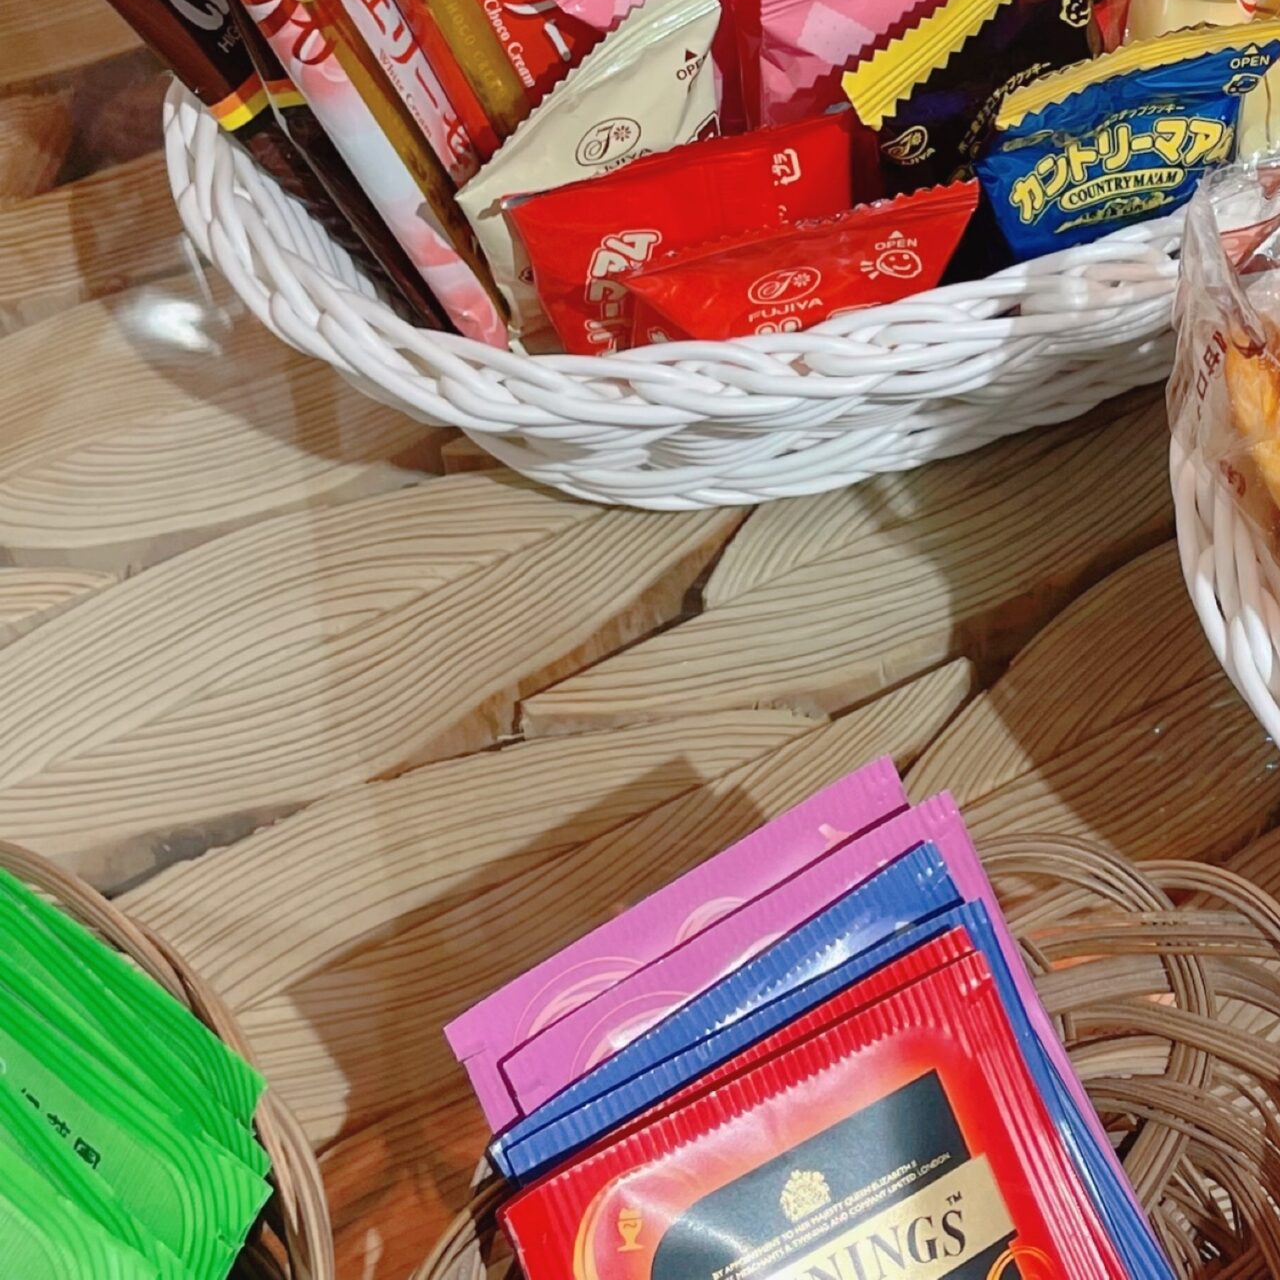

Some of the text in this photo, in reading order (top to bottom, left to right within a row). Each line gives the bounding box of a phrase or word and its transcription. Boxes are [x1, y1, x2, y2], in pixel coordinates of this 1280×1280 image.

[506, 41, 536, 89] Cream
[1230, 54, 1270, 70] OPEN
[378, 47, 434, 140] White Cream
[874, 236, 919, 252] OPEN
[747, 297, 823, 323] FUJIYA
[829, 1213, 850, 1230] AND
[848, 1191, 887, 1216] COMPANY
[885, 1170, 918, 1198] LIMITED
[916, 1151, 952, 1178] LONDON
[723, 1236, 782, 1276] APPOINTMENT
[781, 1229, 794, 1241] TO
[794, 1221, 811, 1236] HER
[810, 1203, 845, 1227] MAJESTY
[843, 1187, 873, 1208] QUEEN
[870, 1161, 913, 1193] ELIZABETH
